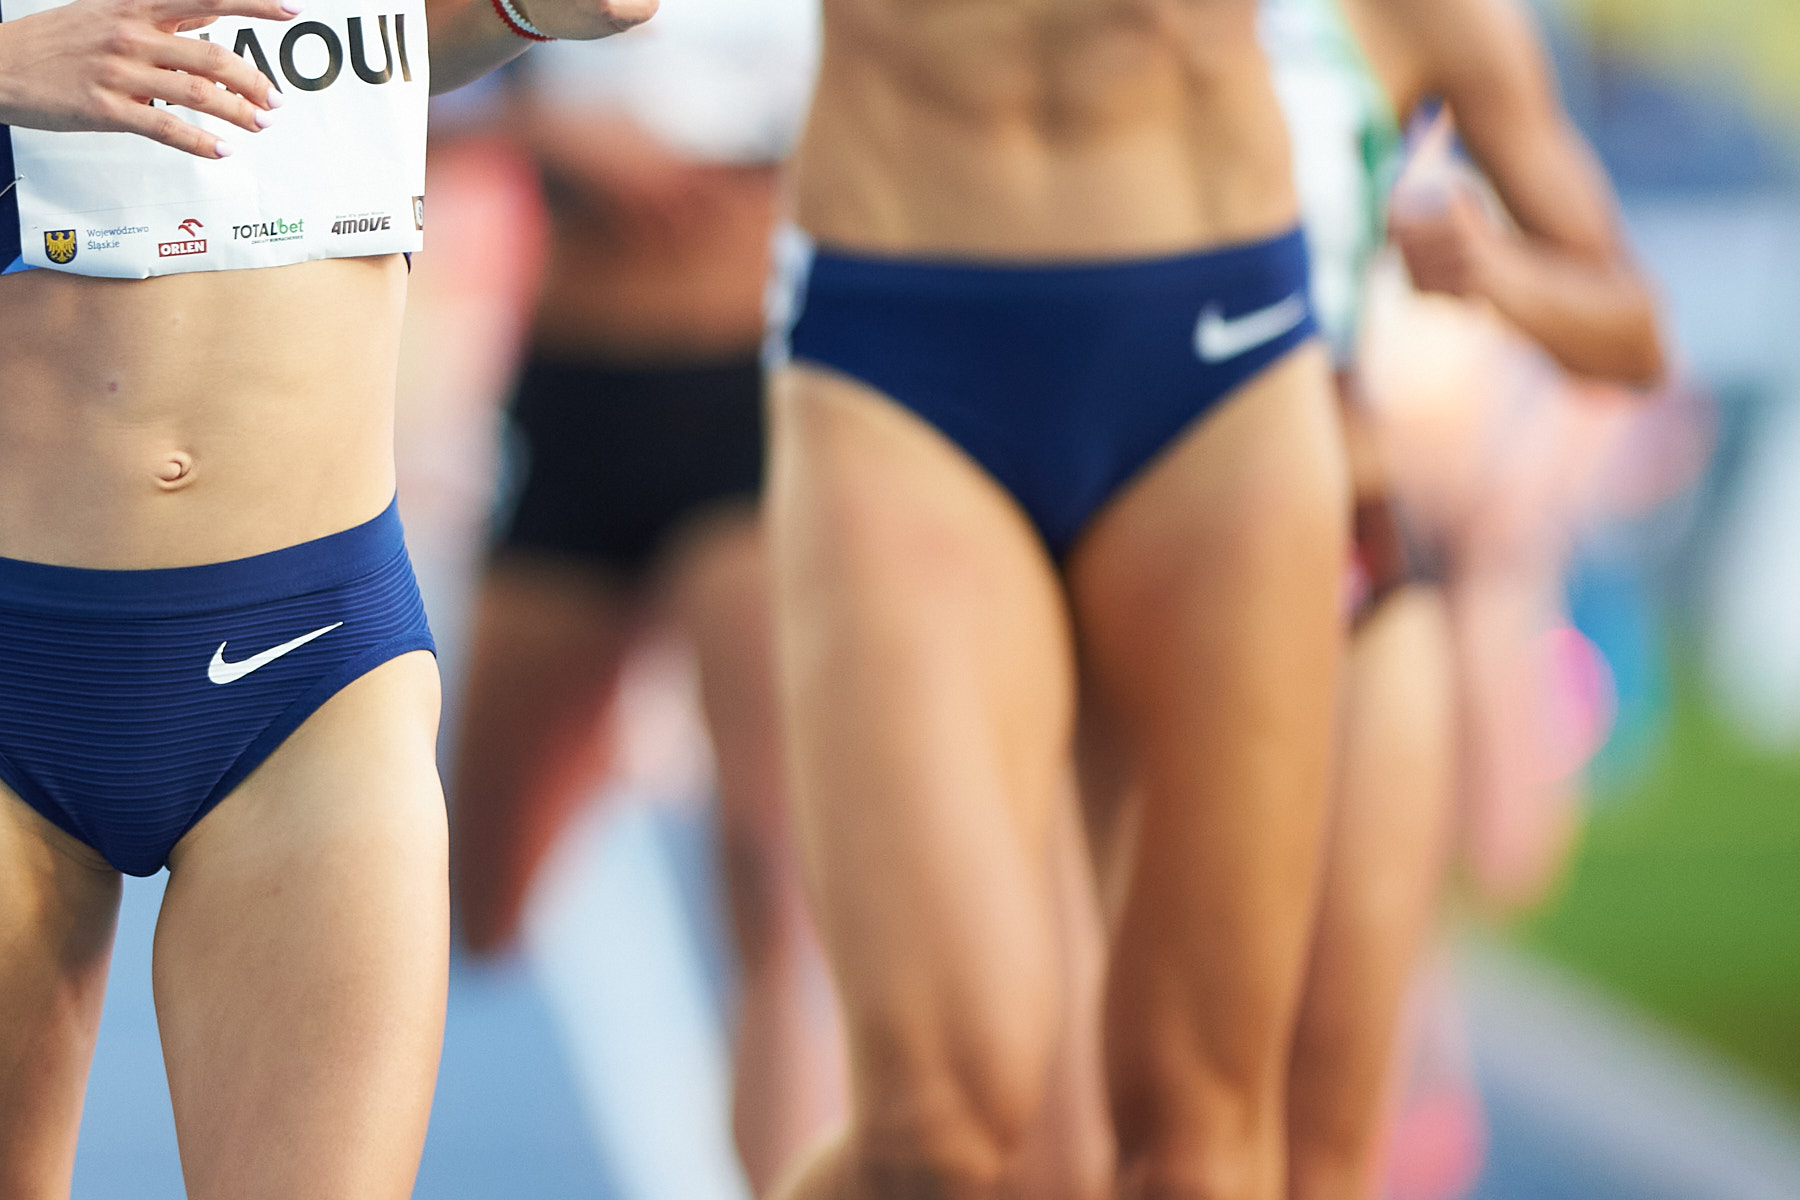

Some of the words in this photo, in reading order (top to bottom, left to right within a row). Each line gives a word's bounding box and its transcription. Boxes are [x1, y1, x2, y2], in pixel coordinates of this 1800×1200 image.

[86, 224, 150, 239] Województwo
[232, 217, 305, 240] TOTALbet
[331, 215, 392, 235] 4MOVE
[160, 241, 206, 256] ORLEN
